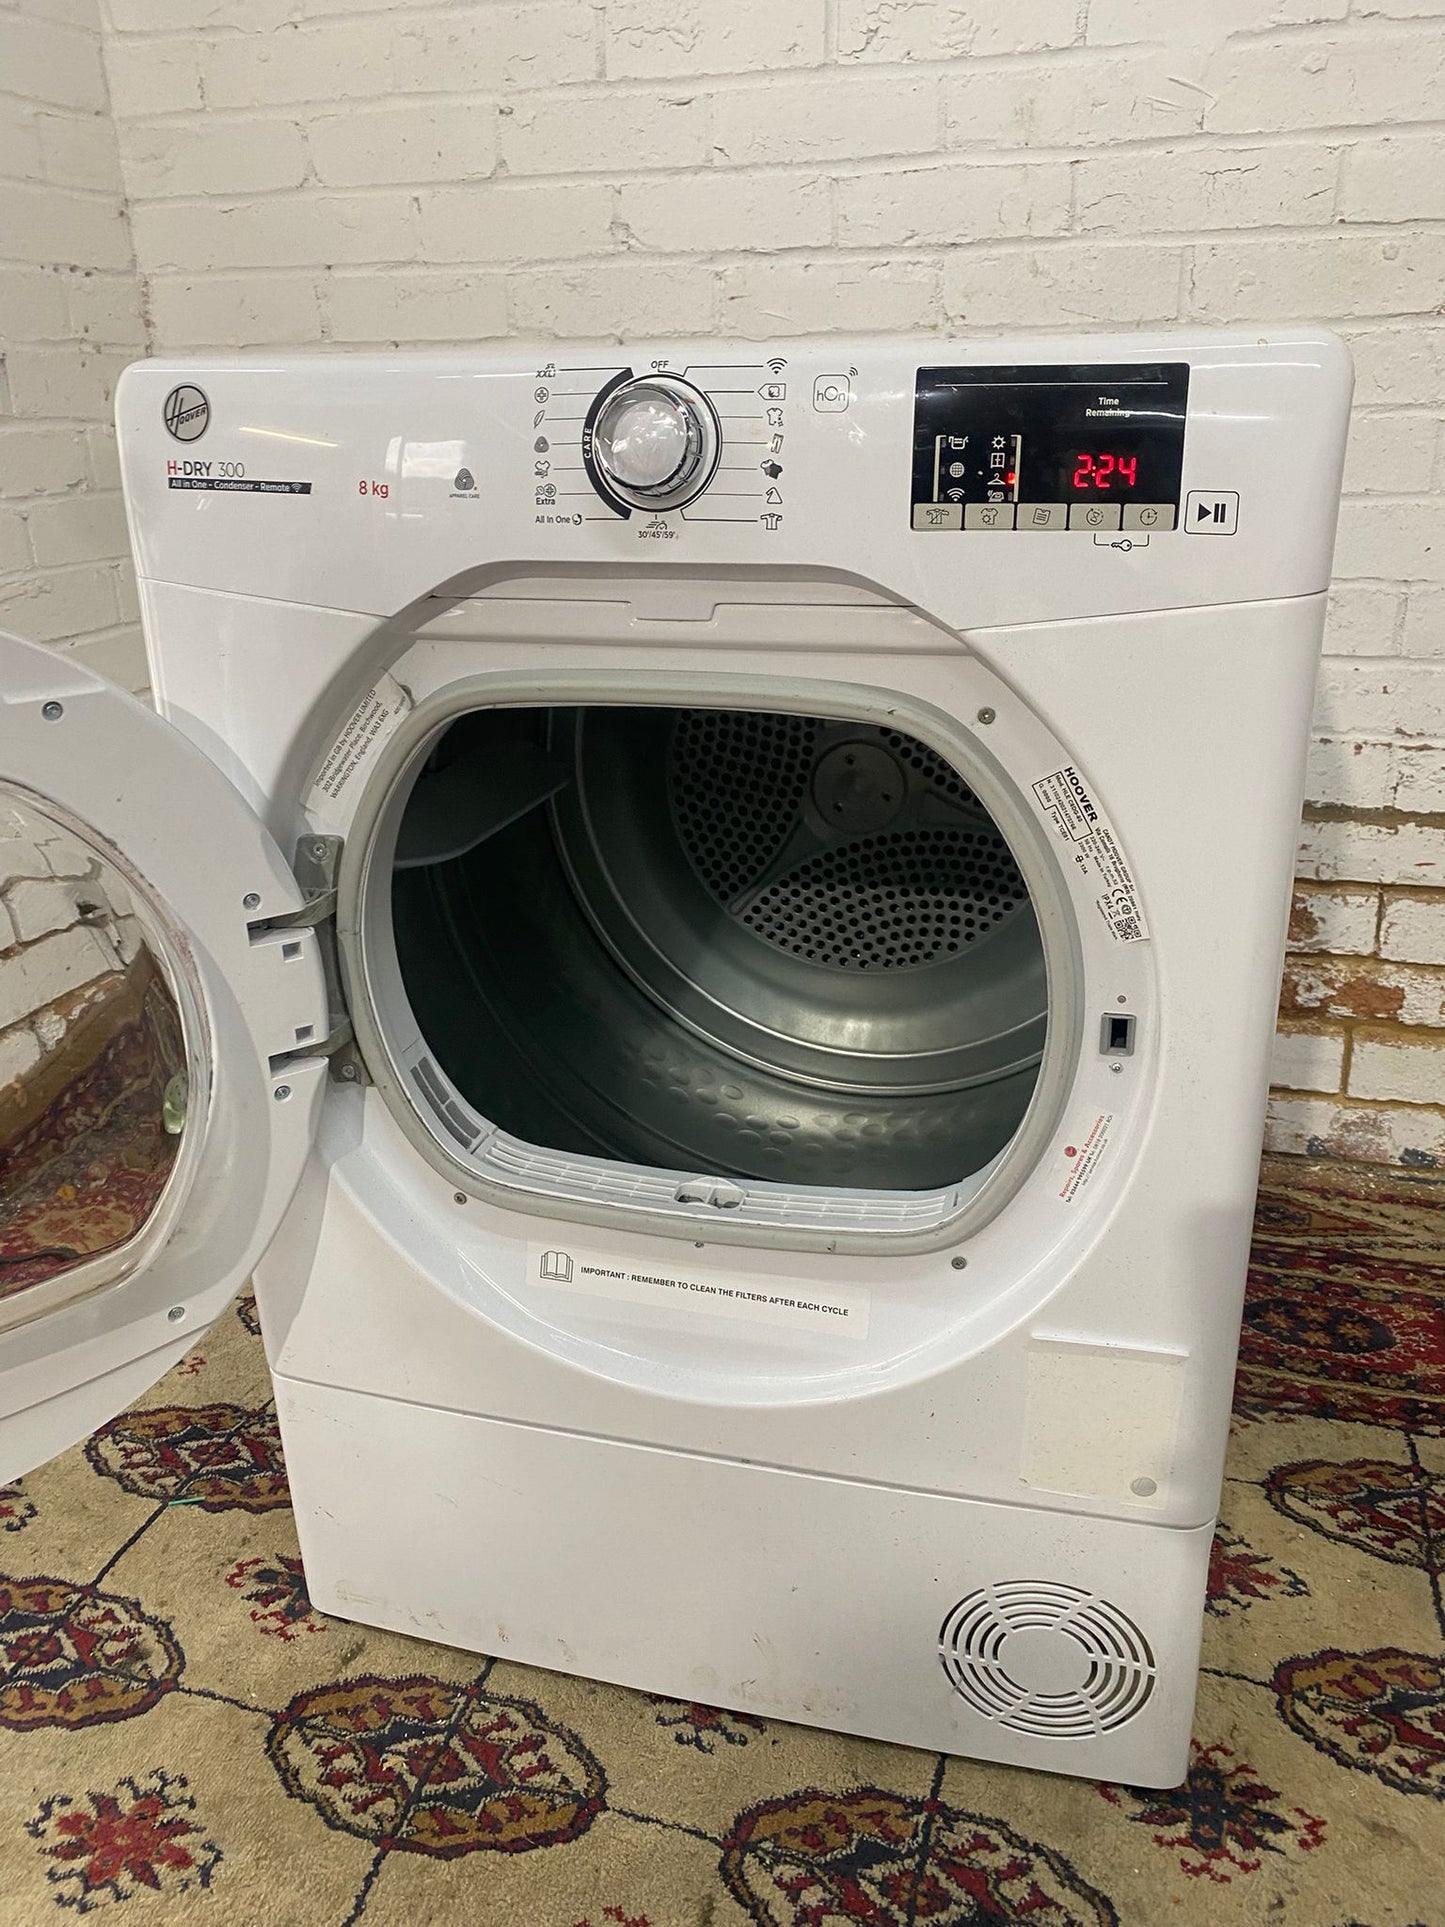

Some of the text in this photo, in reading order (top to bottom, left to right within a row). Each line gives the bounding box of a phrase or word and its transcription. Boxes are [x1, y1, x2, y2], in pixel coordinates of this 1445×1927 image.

[651, 360, 669, 369] OFF
[816, 385, 846, 401] hOn
[1098, 397, 1119, 406] Time
[1085, 408, 1130, 418] Remaining
[583, 427, 592, 459] CARE
[167, 460, 245, 478] H-DRY 300
[1072, 454, 1137, 489] 2:24
[171, 479, 181, 488] All
[183, 480, 191, 489] in
[191, 480, 207, 489] One
[213, 481, 253, 491] Condenser
[260, 482, 290, 492] Remote
[359, 481, 389, 499] 8 kg
[535, 496, 556, 505] Extra
[535, 515, 545, 524] All
[555, 515, 570, 525] One
[314, 758, 333, 786] Imported
[333, 744, 342, 754] GB
[343, 712, 361, 738] HOOVER
[358, 688, 376, 715] LIMITED
[354, 736, 372, 760] England,
[369, 721, 381, 735] WA3
[378, 708, 388, 722] 6XG
[322, 700, 382, 792] 302 Bridgewater Place, Birchwood,
[1055, 774, 1063, 786] Mod.
[1062, 787, 1070, 799] HLE
[1064, 767, 1097, 821] HOOVER
[1051, 811, 1059, 824] Type
[1102, 828, 1113, 844] CANDY
[1111, 846, 1123, 865] HOOVER
[1120, 866, 1131, 882] GROUP
[1101, 893, 1113, 909] IPX4
[1111, 888, 1127, 905] CE
[1071, 1154, 1085, 1174] Spares
[1085, 1115, 1105, 1148] Accessories
[581, 1266, 625, 1280] IMPORTANT
[631, 1274, 675, 1288] REMEMBER
[677, 1281, 688, 1290] TO
[690, 1284, 716, 1294] CLEAN
[718, 1288, 734, 1297] THE
[735, 1291, 768, 1303] FILTERS
[769, 1296, 795, 1308] AFTER
[797, 1301, 820, 1312] EACH
[822, 1304, 849, 1316] CYCLE
